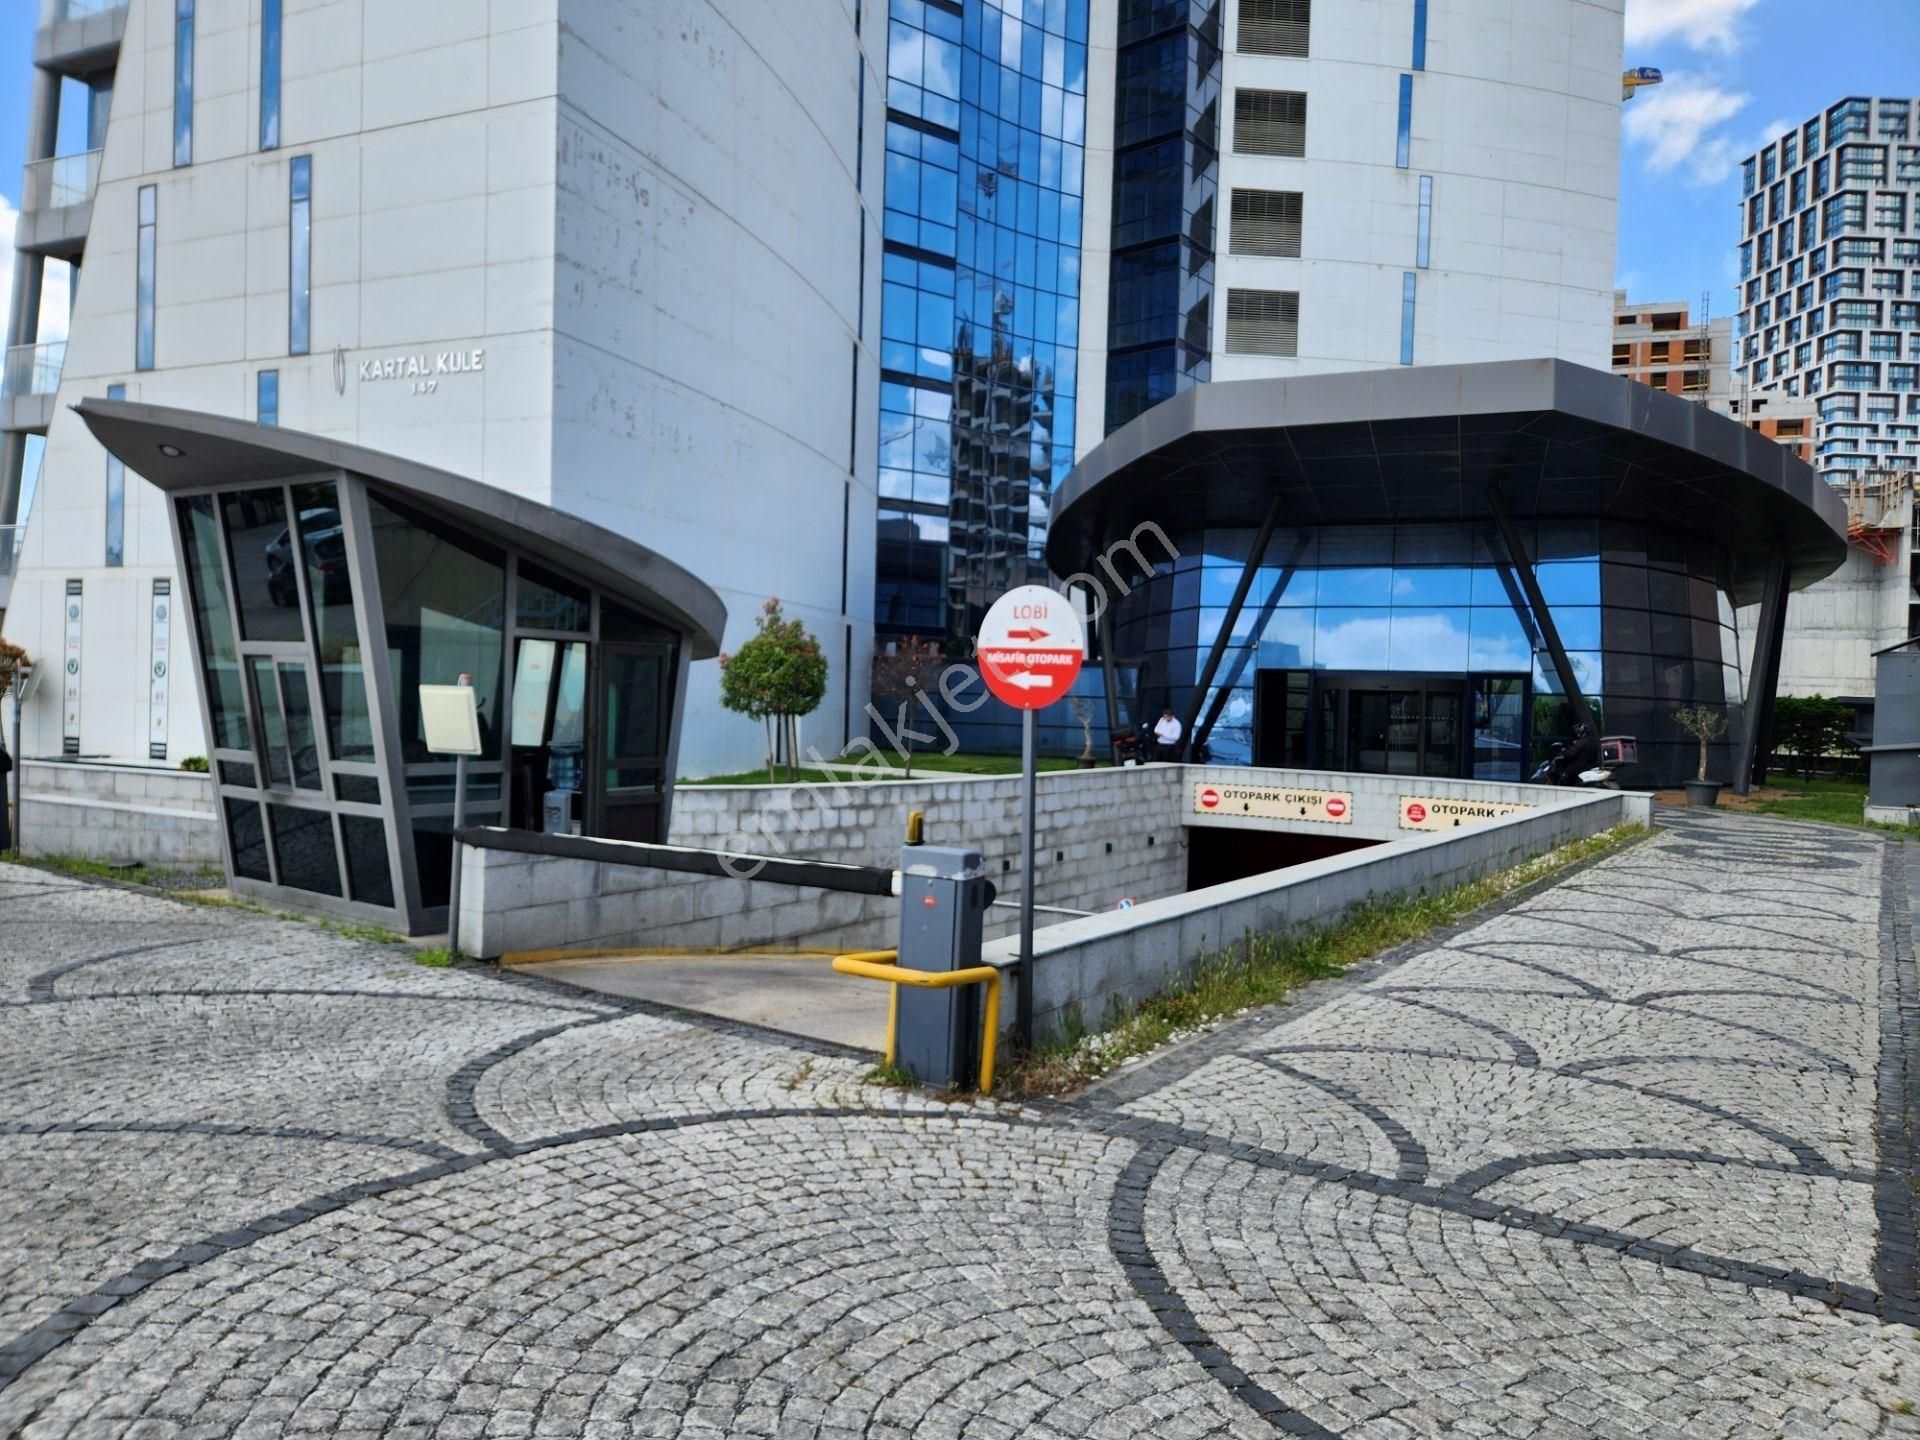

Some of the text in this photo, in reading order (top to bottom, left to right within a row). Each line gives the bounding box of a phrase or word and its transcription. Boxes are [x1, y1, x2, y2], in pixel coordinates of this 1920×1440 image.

[360, 349, 485, 381] KARTAL KULE
[412, 380, 438, 395] 147
[1013, 602, 1048, 619] LOBİ
[987, 650, 1074, 665] MİSAFİR OTOPARK
[1223, 790, 1322, 806] OTOPARK ÇIKIŞI
[1431, 804, 1496, 818] OTOPARK
